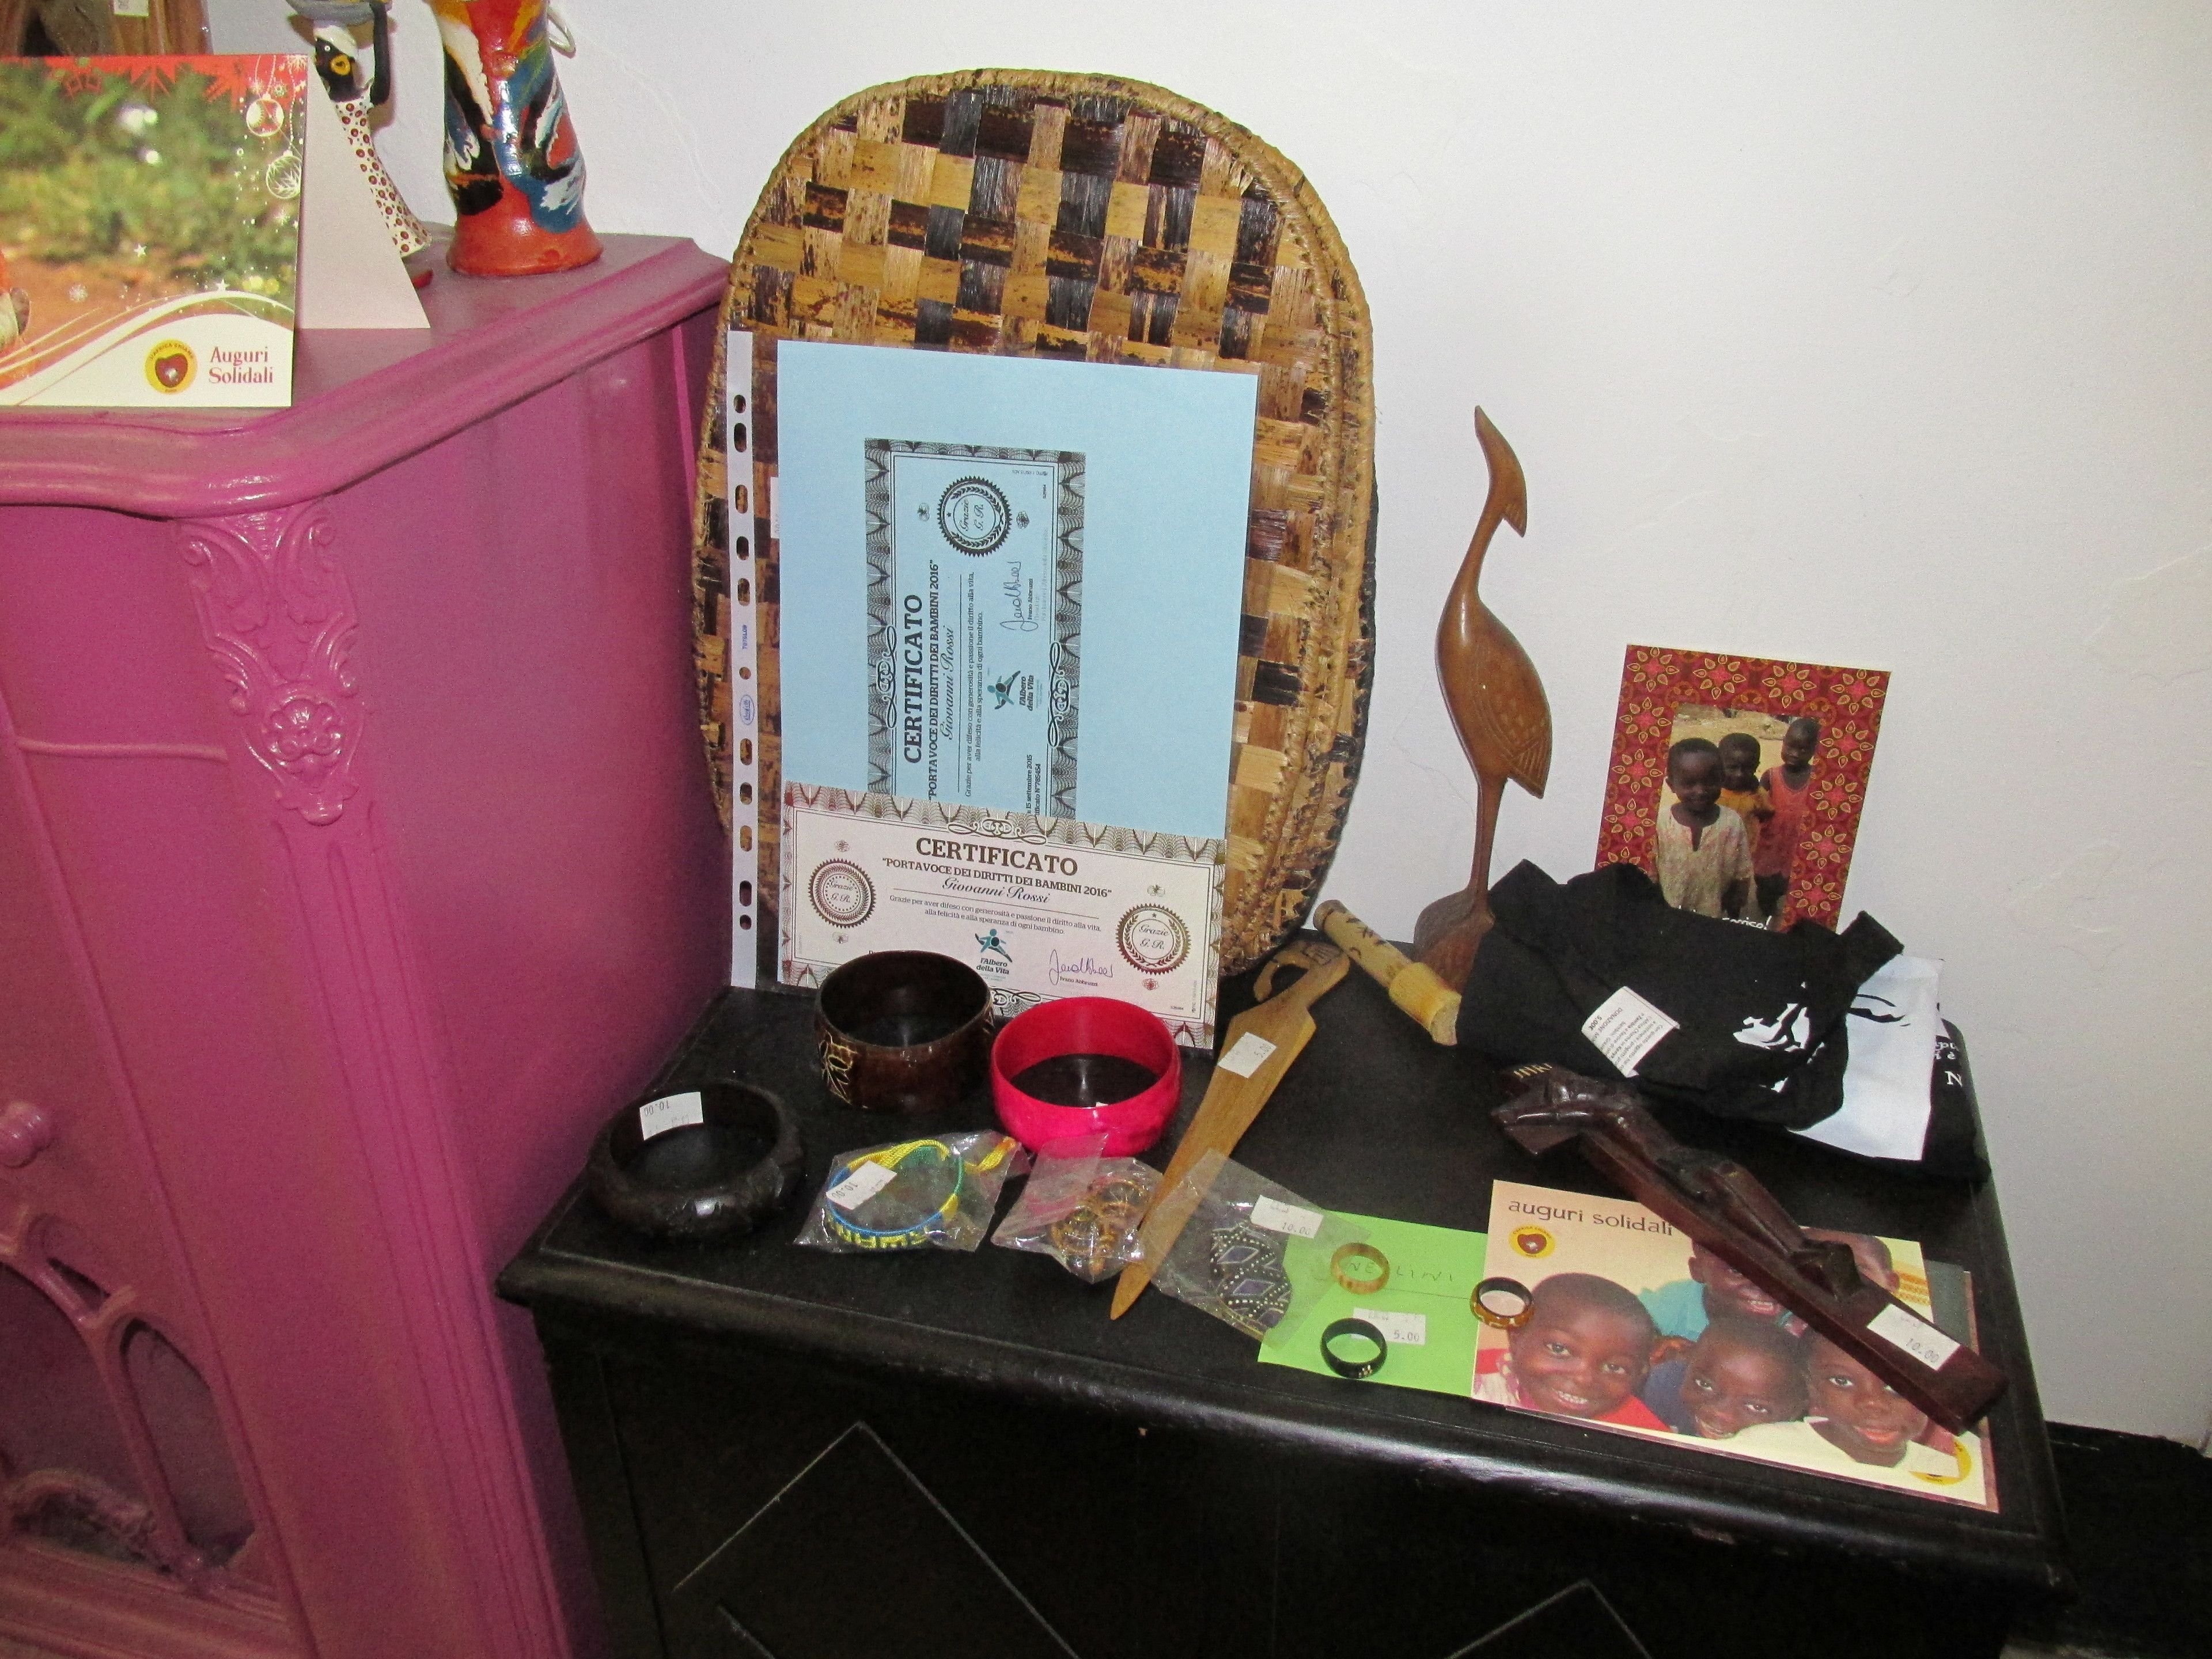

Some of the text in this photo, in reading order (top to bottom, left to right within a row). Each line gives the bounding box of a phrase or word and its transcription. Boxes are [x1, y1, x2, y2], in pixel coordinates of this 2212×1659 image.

[210, 346, 268, 366] Auguri
[209, 366, 273, 384] Solidali
[959, 499, 969, 532] Grazie
[930, 592, 939, 641] BAMBINI
[930, 643, 939, 662] DEI
[904, 594, 923, 764] CERTIFICATO
[930, 663, 939, 706] DIRITTI
[940, 625, 955, 741] Giovanni Rossi
[929, 707, 938, 726] DEI
[916, 837, 1078, 876] CERTIFICATO
[830, 879, 854, 891] Grazie
[942, 877, 1051, 903] Giovanni Rossi
[953, 867, 971, 877] DEI
[974, 869, 1013, 883] DIRITTI
[1015, 876, 1033, 887] DEI
[1035, 878, 1082, 894] BAMBINI
[889, 895, 911, 903] Grazie
[940, 901, 960, 911] difeso
[975, 907, 1010, 917] generosità
[1016, 914, 1046, 923] passione
[1052, 918, 1073, 927] diritto
[1074, 921, 1086, 930] alla
[1087, 923, 1101, 932] vita,
[937, 910, 960, 919] felicità
[979, 916, 1009, 926] speranza
[1033, 923, 1065, 934] bambino.
[1139, 924, 1169, 937] Grazie
[976, 964, 1009, 975] della Vita
[980, 957, 1007, 967] l'Albero
[1597, 1006, 1623, 1032] DONAZIONE
[1627, 1014, 1642, 1029] Zambia
[643, 1100, 669, 1116] 10.00
[831, 1182, 858, 1199] 10.00
[1508, 1200, 1673, 1236] auguri solidali
[1393, 1329, 1420, 1342] 5.00
[1906, 1338, 1940, 1363] 10.00
